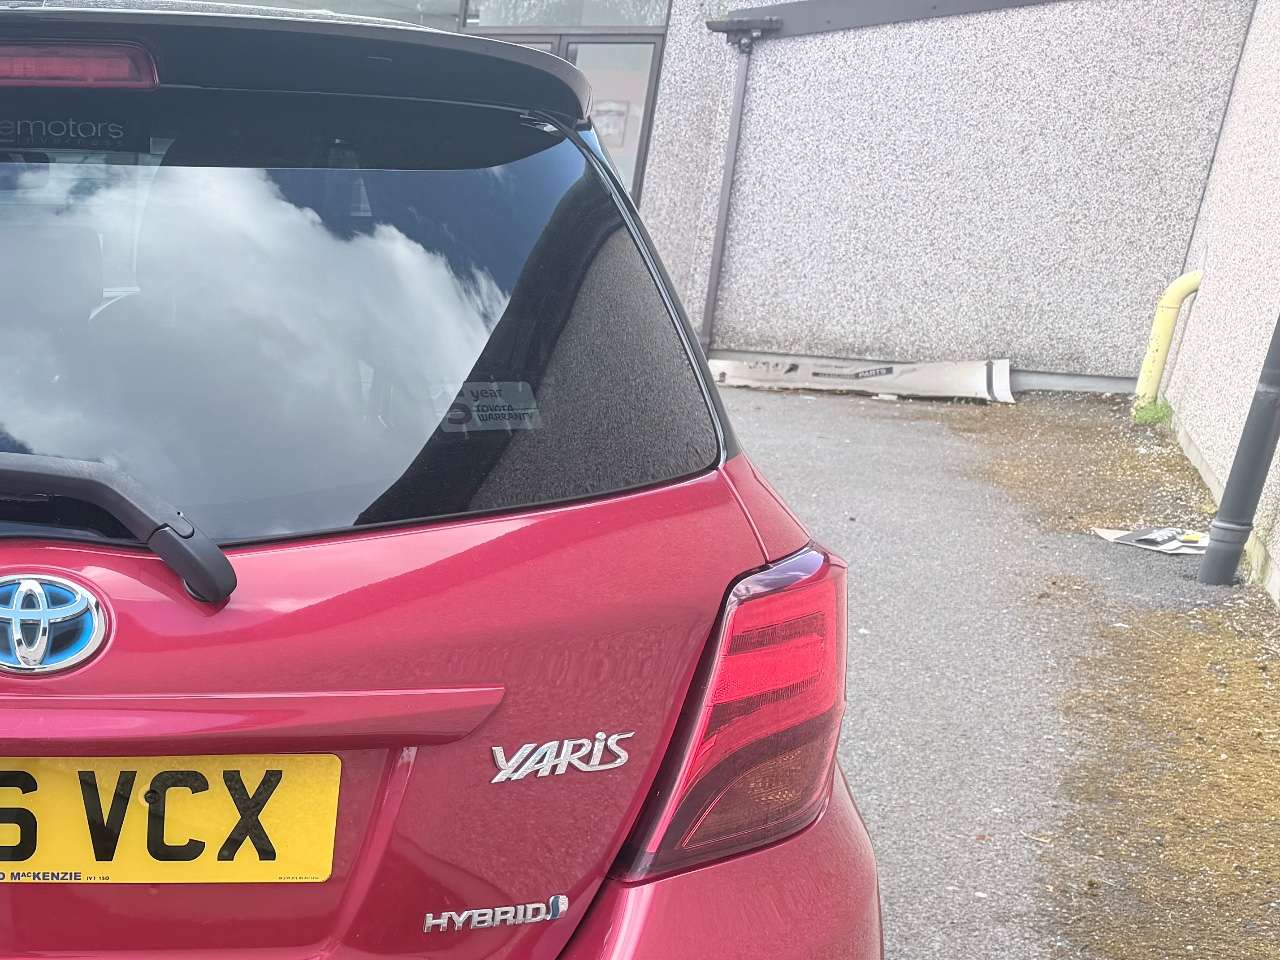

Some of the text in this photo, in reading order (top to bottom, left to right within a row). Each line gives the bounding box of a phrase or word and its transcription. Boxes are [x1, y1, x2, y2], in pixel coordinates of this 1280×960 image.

[470, 388, 503, 402] year
[77, 769, 283, 862] VCX
[423, 902, 549, 933] HYBRID
